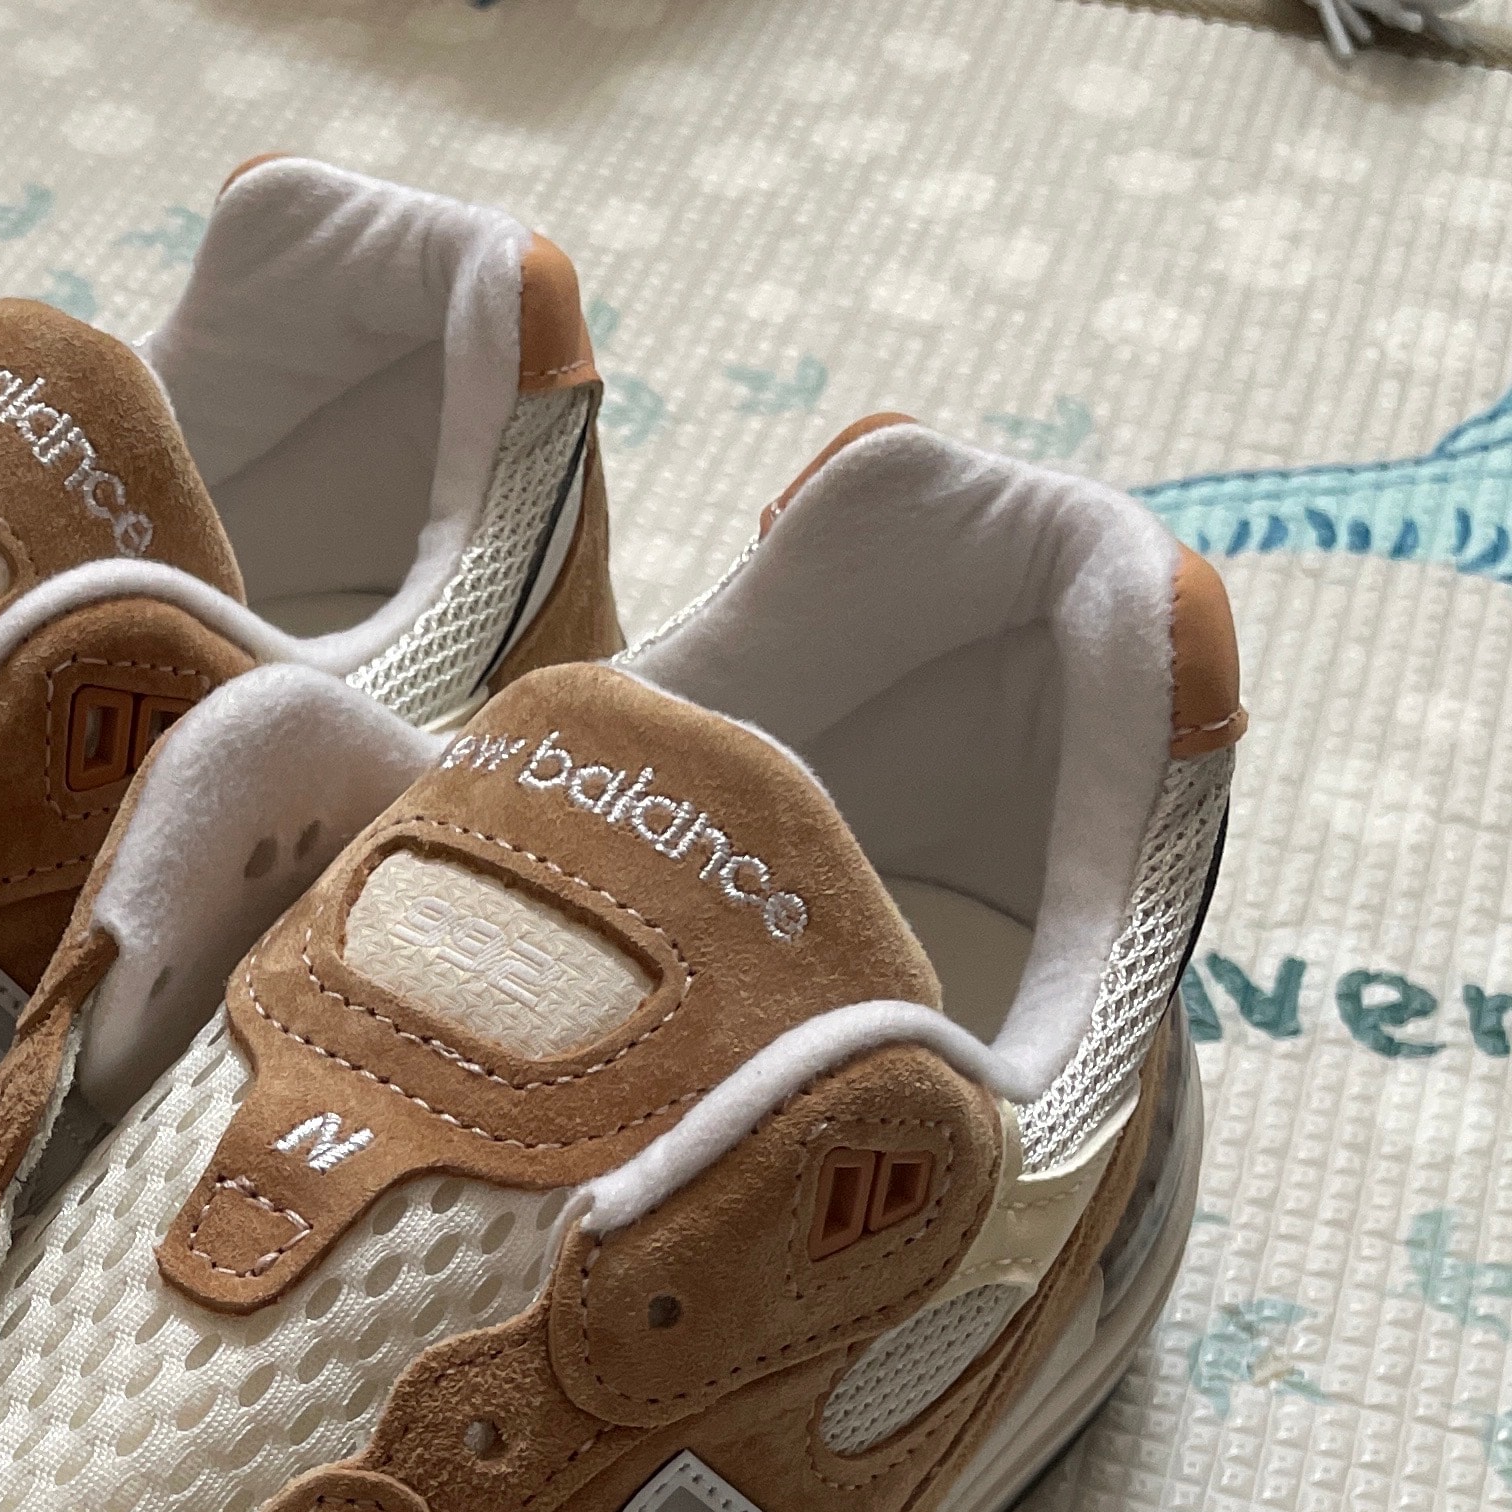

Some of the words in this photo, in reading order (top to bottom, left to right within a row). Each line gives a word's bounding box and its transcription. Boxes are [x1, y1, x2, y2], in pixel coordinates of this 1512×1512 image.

[441, 735, 526, 770] ew
[518, 731, 809, 942] balance
[274, 1112, 374, 1172] N
